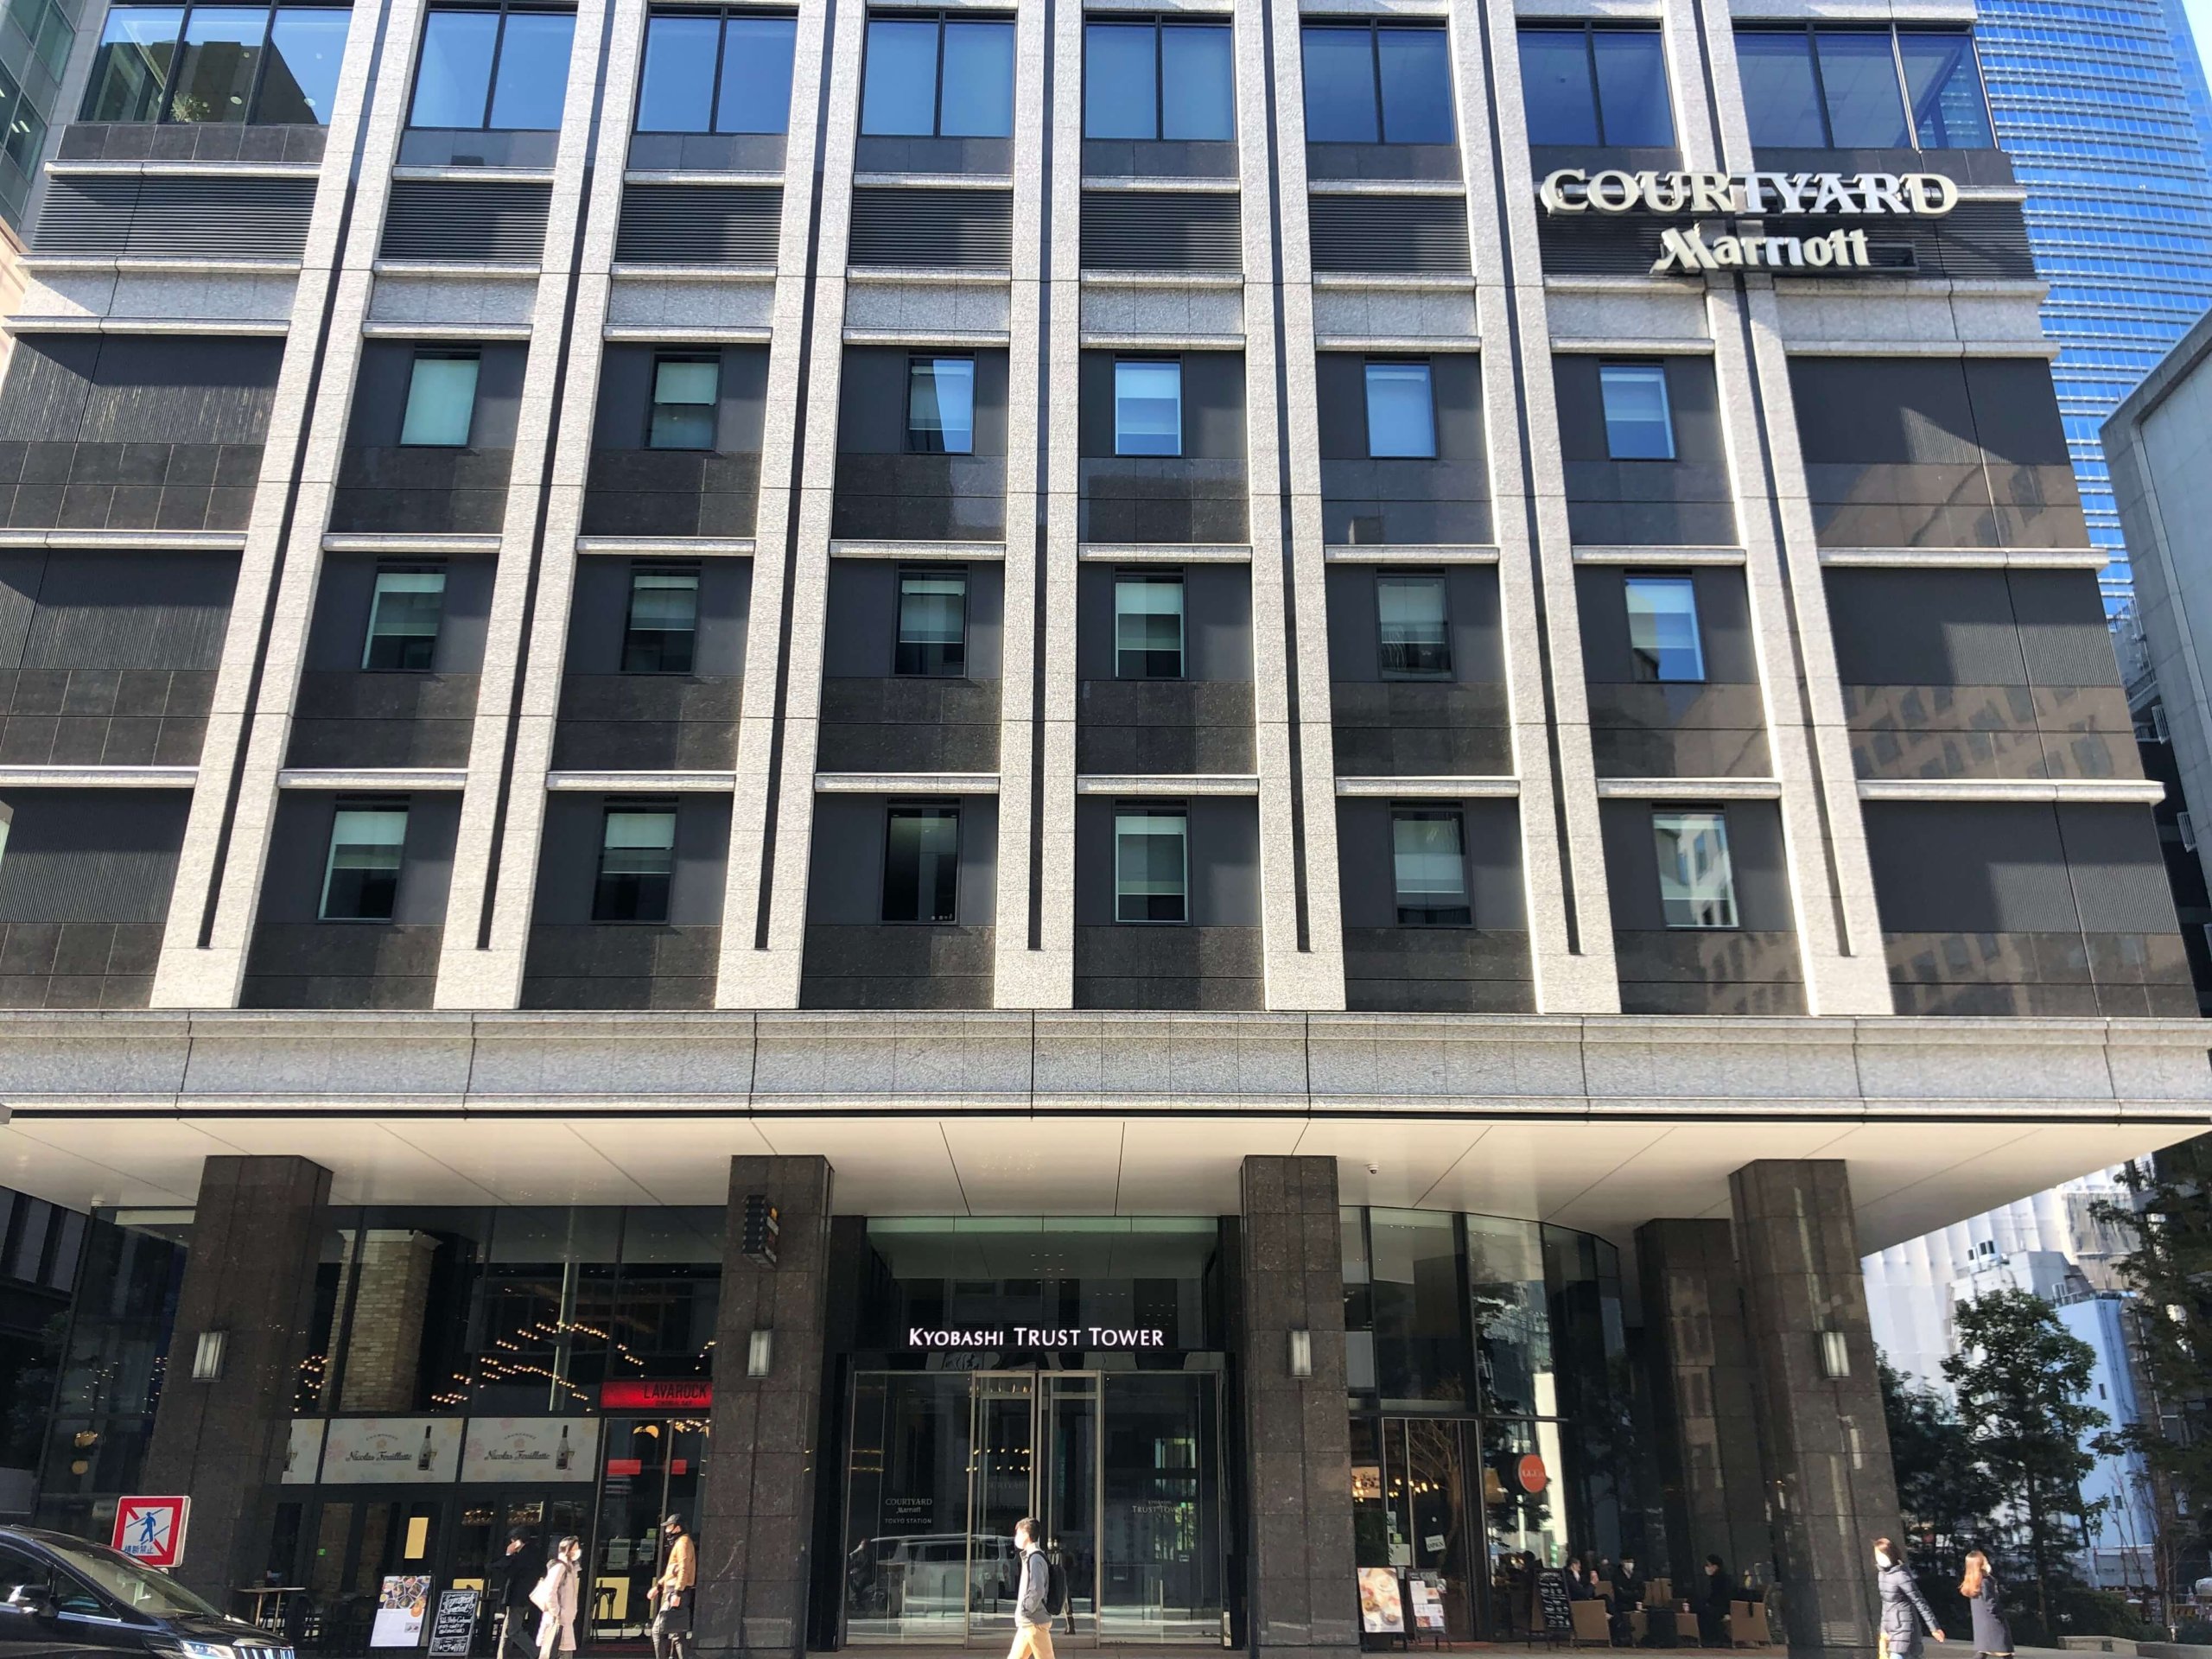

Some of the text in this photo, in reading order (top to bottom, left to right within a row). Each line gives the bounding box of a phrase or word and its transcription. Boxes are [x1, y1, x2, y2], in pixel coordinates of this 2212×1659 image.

[1540, 168, 1959, 218] COURTYARD
[1649, 228, 1869, 274] Marriott
[909, 1327, 1165, 1347] KYOBASHI TRUST TOWER
[643, 1382, 708, 1399] LAVAROCK
[885, 1497, 933, 1506] COURTYARD
[1132, 1505, 1156, 1514] TRUST
